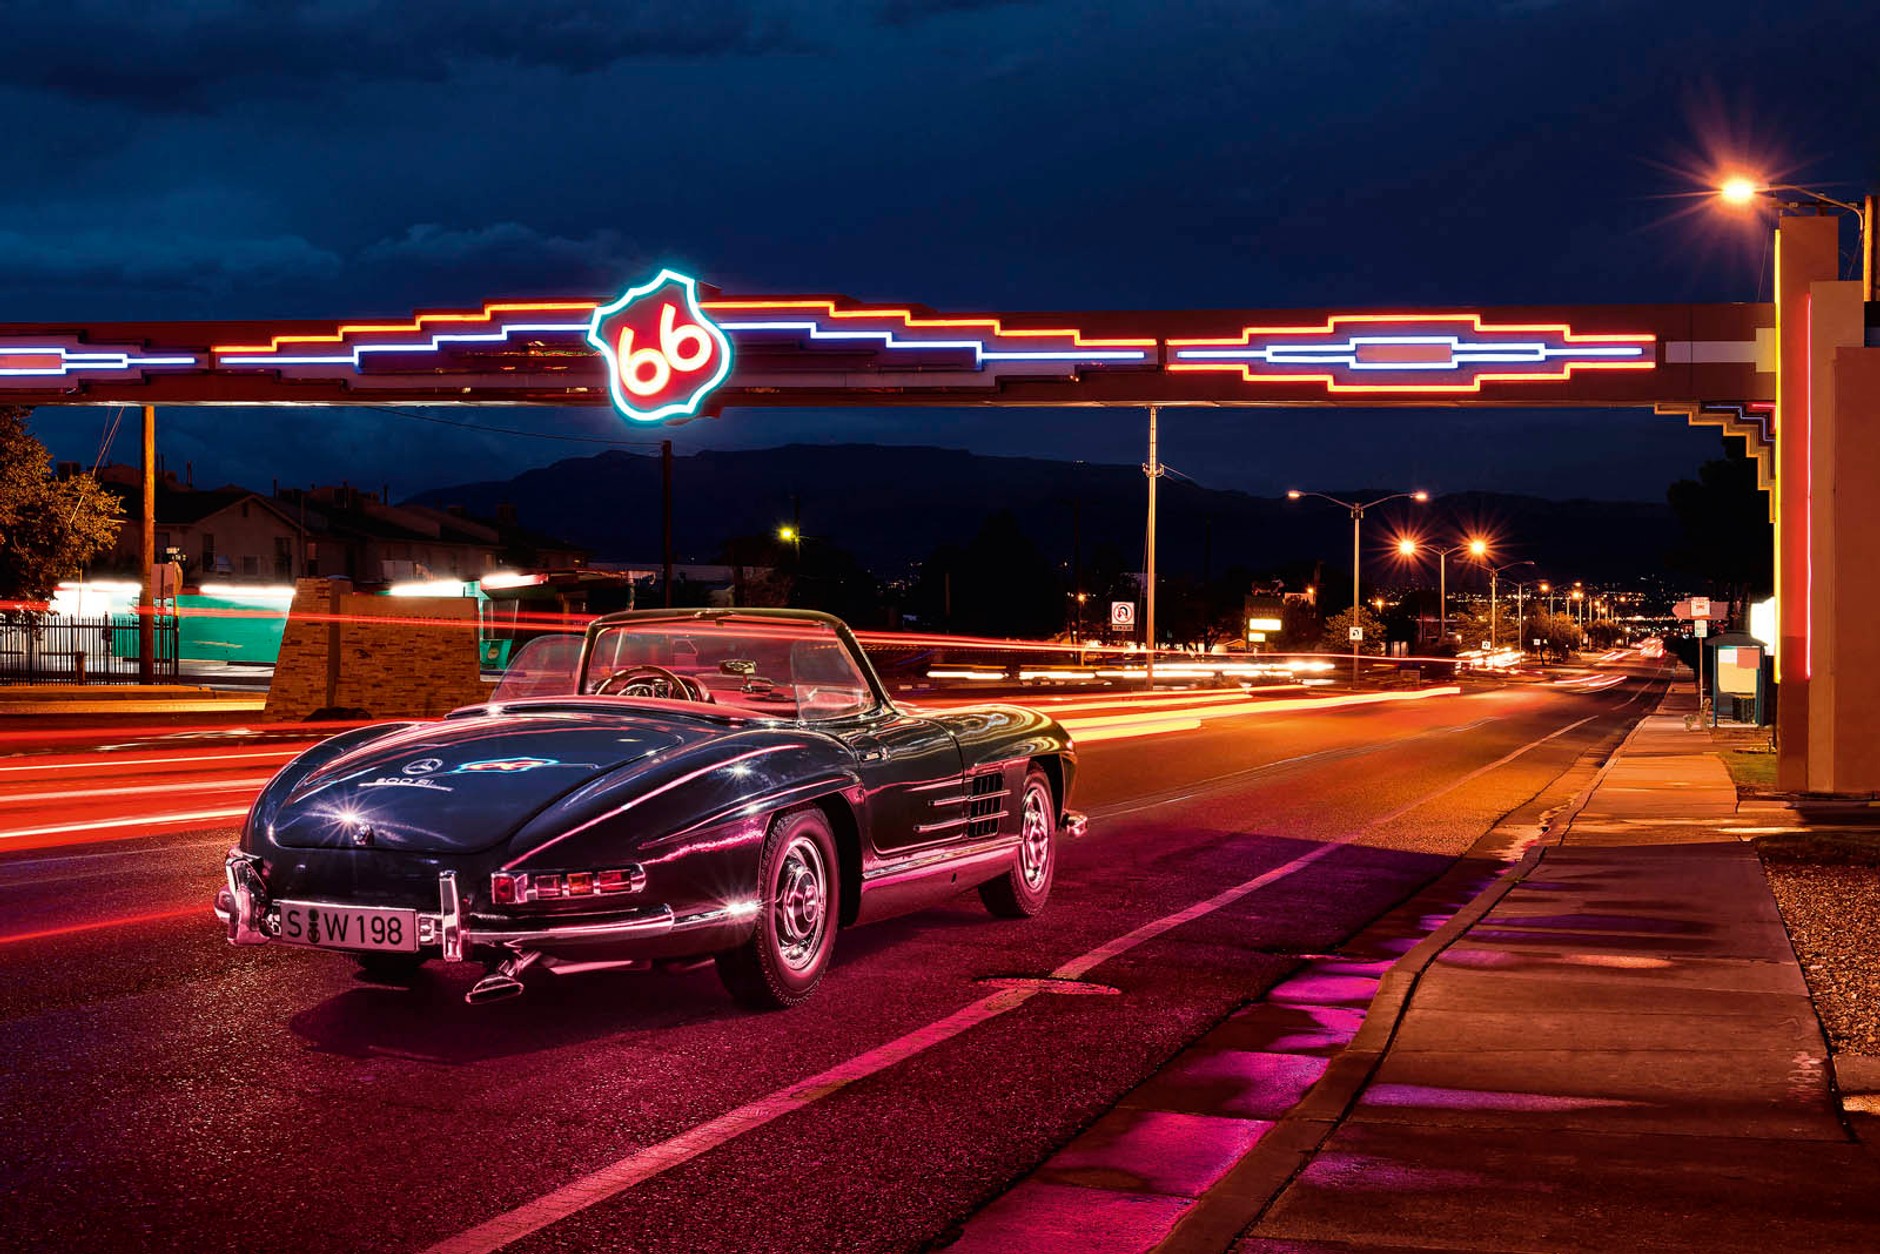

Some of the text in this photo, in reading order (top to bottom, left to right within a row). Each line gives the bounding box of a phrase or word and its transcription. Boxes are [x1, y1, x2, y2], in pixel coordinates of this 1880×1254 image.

[618, 303, 712, 396] 66
[287, 910, 403, 945] S W 198
